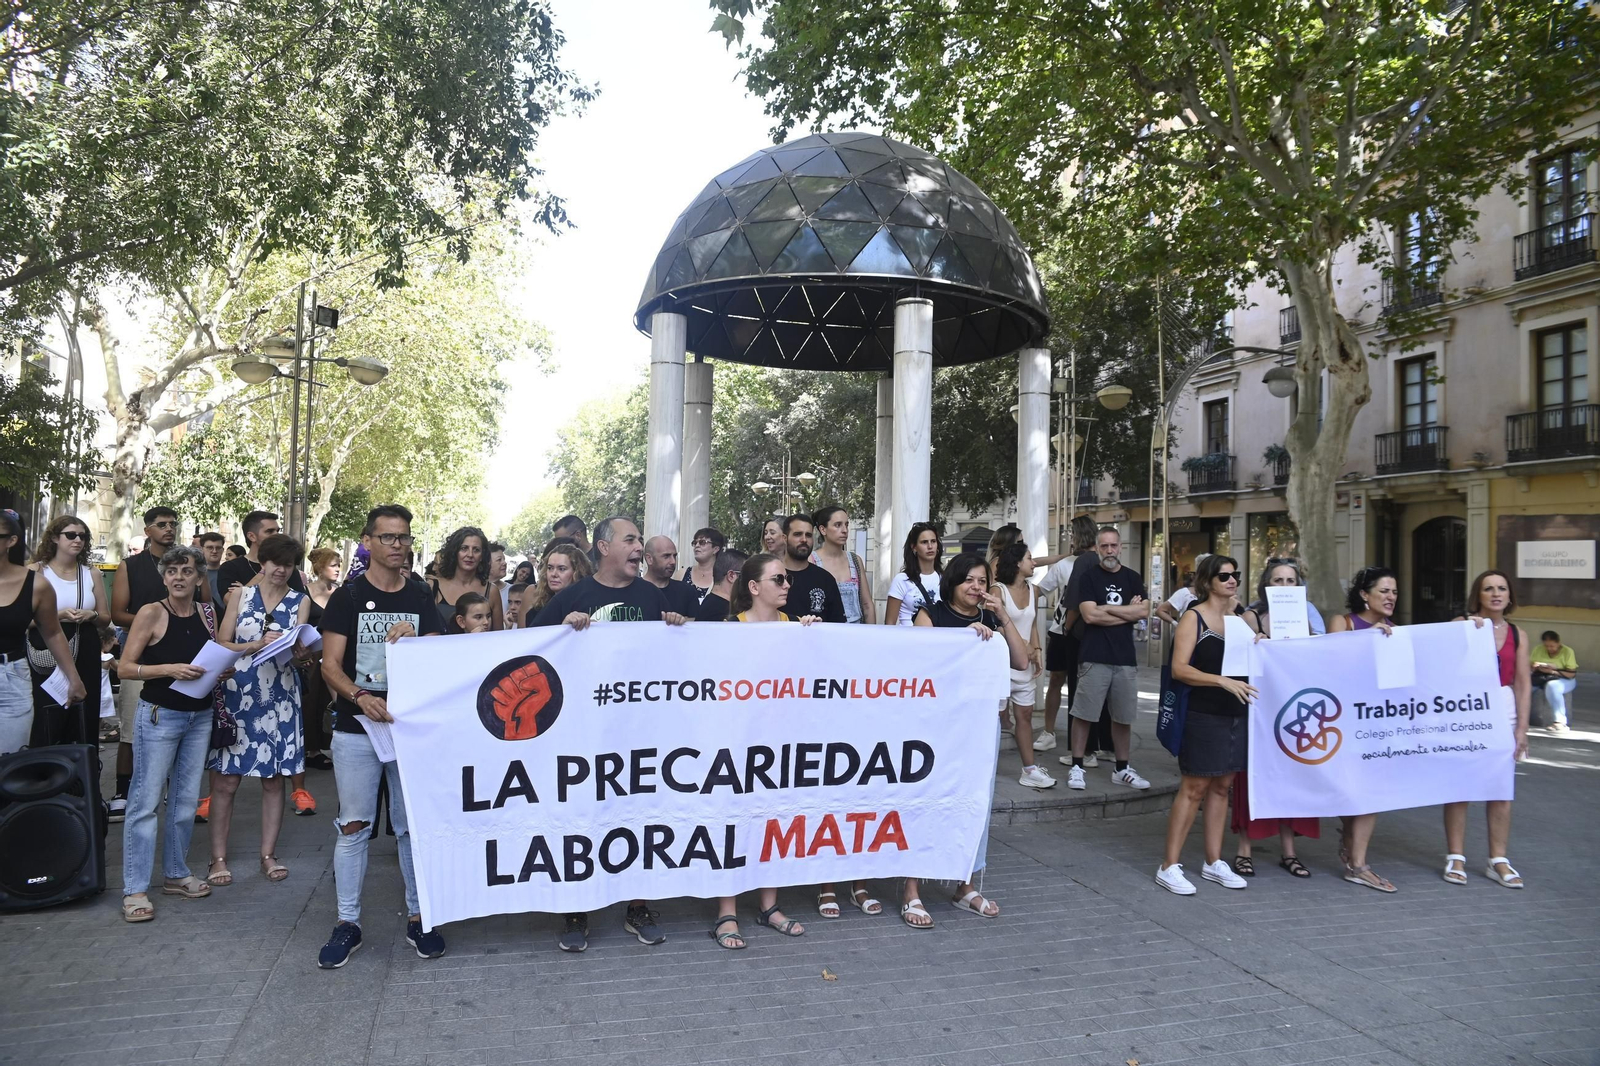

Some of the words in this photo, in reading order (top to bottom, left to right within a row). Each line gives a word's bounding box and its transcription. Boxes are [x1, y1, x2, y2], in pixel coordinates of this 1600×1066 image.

[361, 613, 402, 621] CONTRA
[404, 614, 415, 622] EL
[593, 678, 936, 706] #SECTORSOCIALENLUCHA
[1353, 697, 1428, 721] Trabajo
[1433, 692, 1490, 714] Social
[1355, 729, 1394, 740] Colegio
[1396, 723, 1448, 736] Profesional
[1450, 721, 1493, 732] Córdoba
[1361, 744, 1430, 760] socialmente
[1432, 740, 1488, 753] esenciales
[462, 760, 539, 812] LA
[557, 740, 935, 802] PRECARIEDAD
[486, 824, 746, 886] LABORAL
[759, 811, 908, 862] MATA
